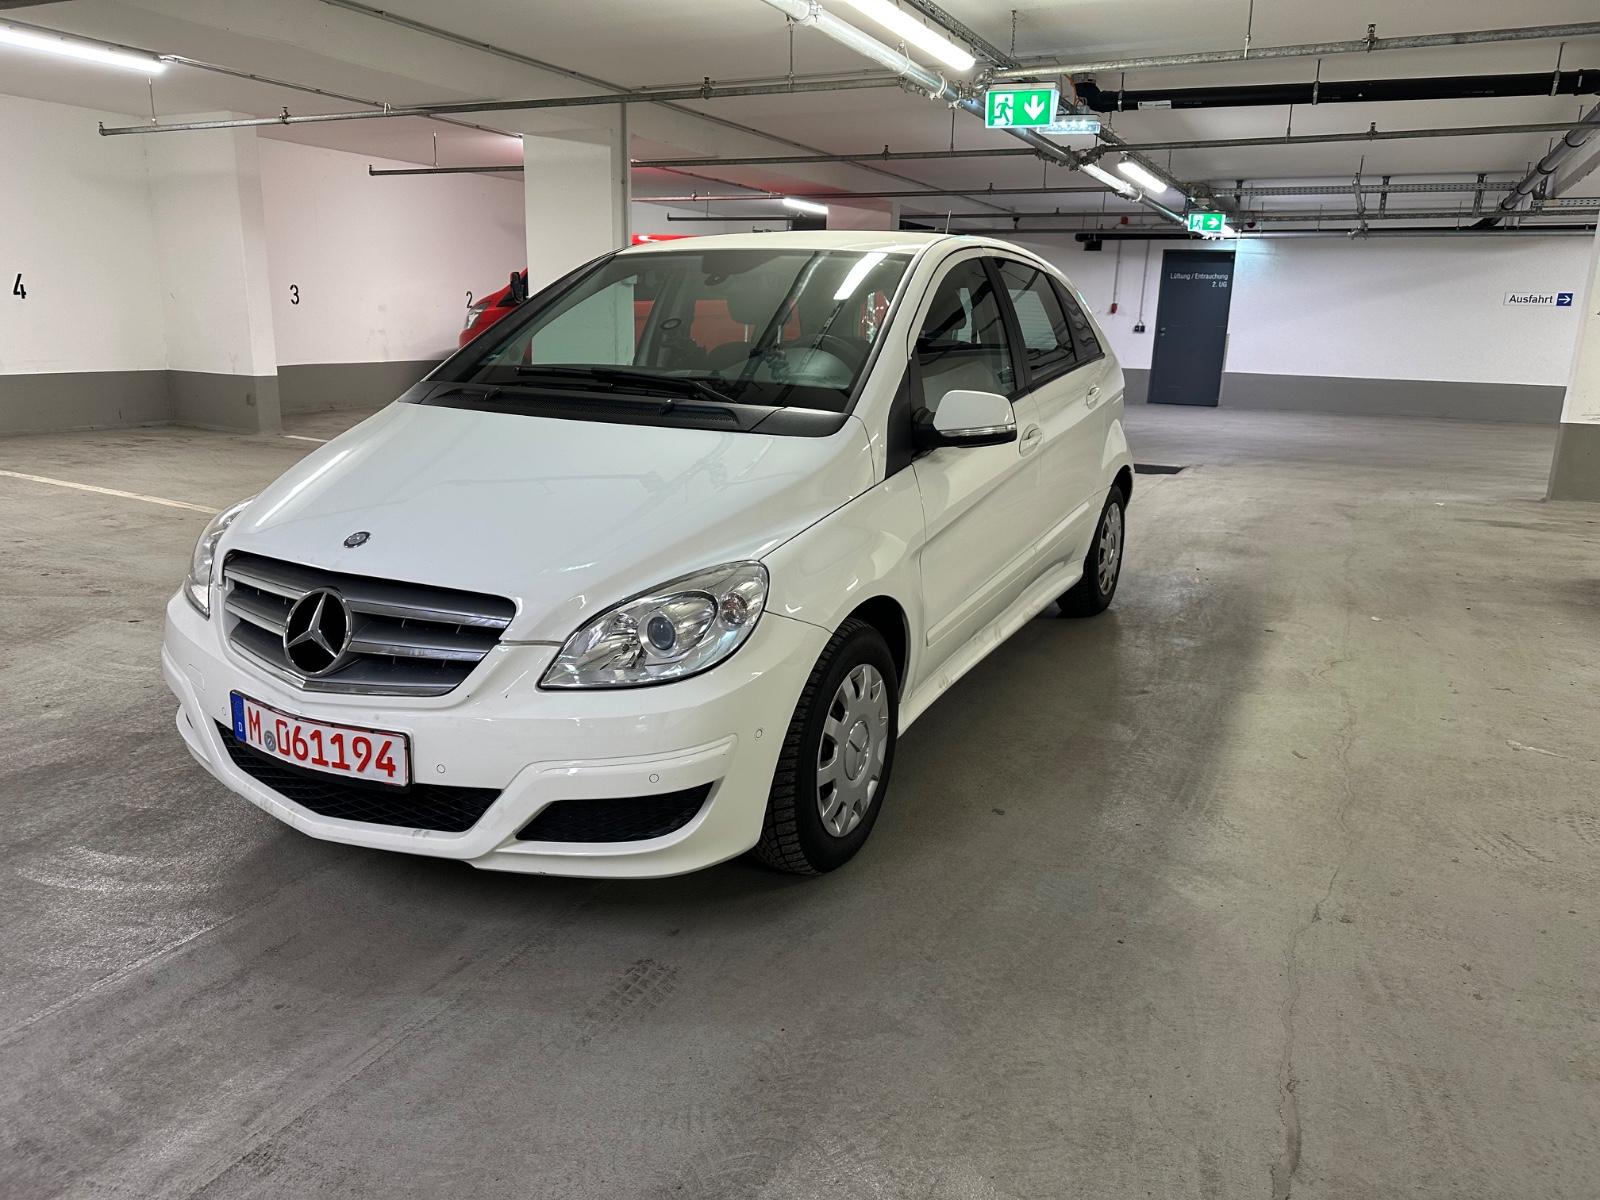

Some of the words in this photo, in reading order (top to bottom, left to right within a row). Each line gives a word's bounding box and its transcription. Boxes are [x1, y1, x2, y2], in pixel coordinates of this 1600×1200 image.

[13, 273, 27, 300] 4
[290, 284, 300, 305] 3
[465, 290, 473, 309] 2
[1509, 295, 1553, 303] Ausfahrt
[247, 706, 263, 746] M
[275, 718, 396, 778] 061194
